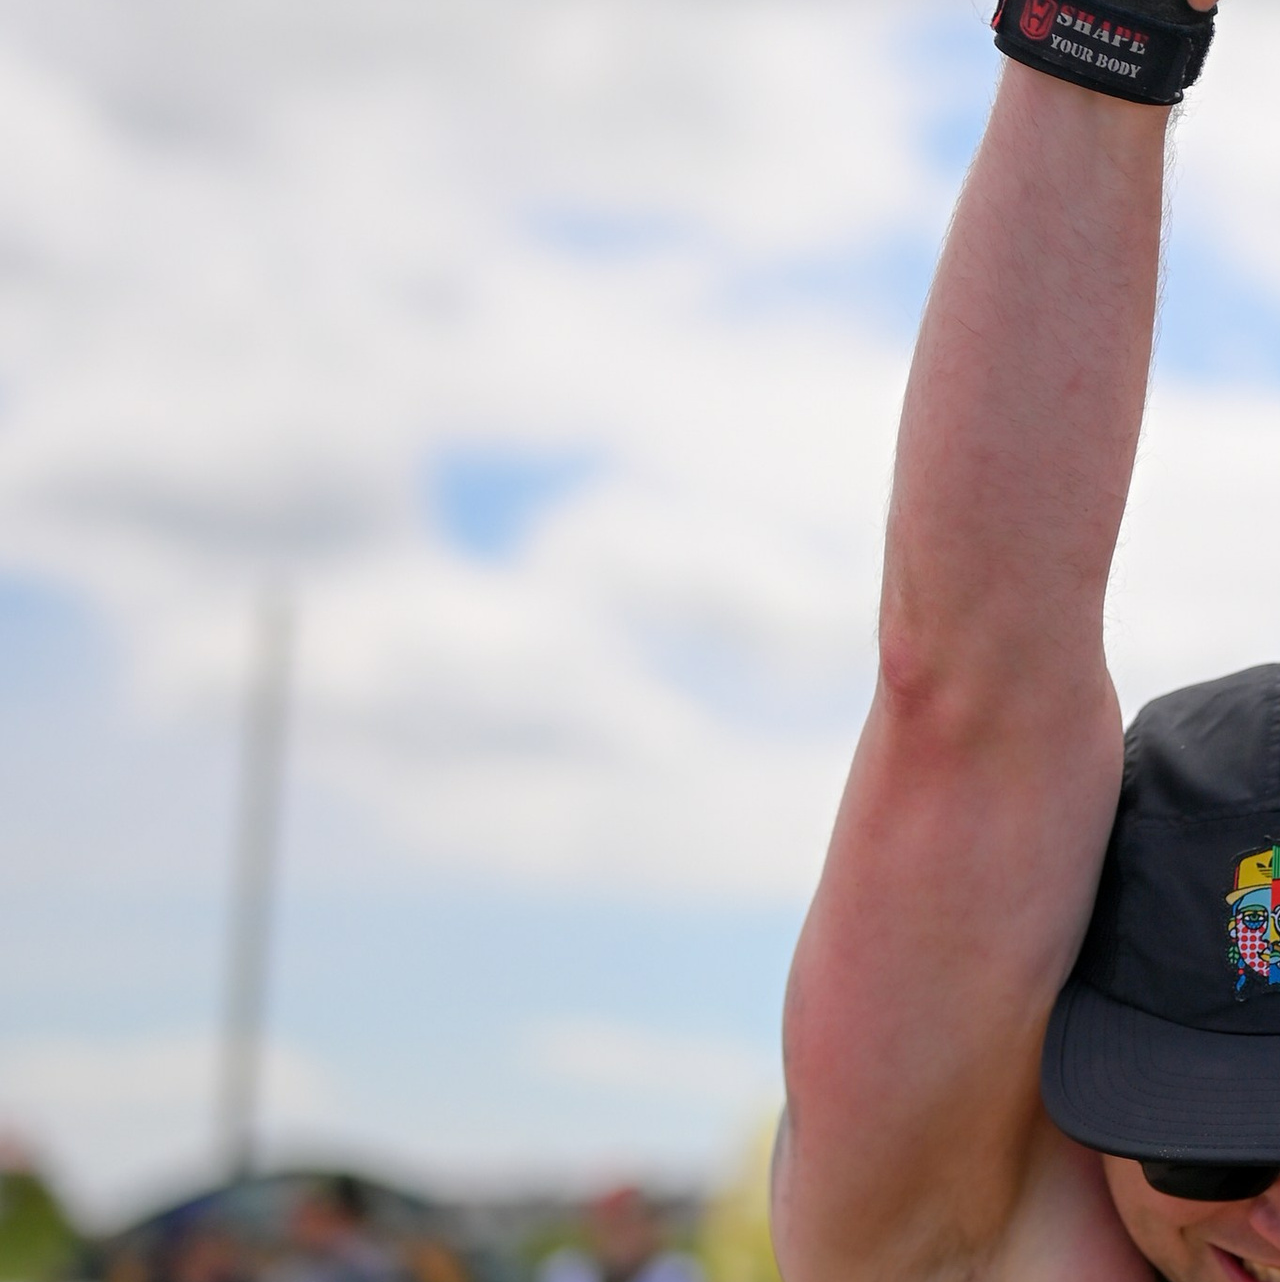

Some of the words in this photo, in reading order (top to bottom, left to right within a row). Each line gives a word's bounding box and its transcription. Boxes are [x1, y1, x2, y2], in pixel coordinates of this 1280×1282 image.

[1056, 3, 1149, 55] SHAPE
[1050, 33, 1094, 64] YOUR
[1096, 53, 1142, 80] BODY
